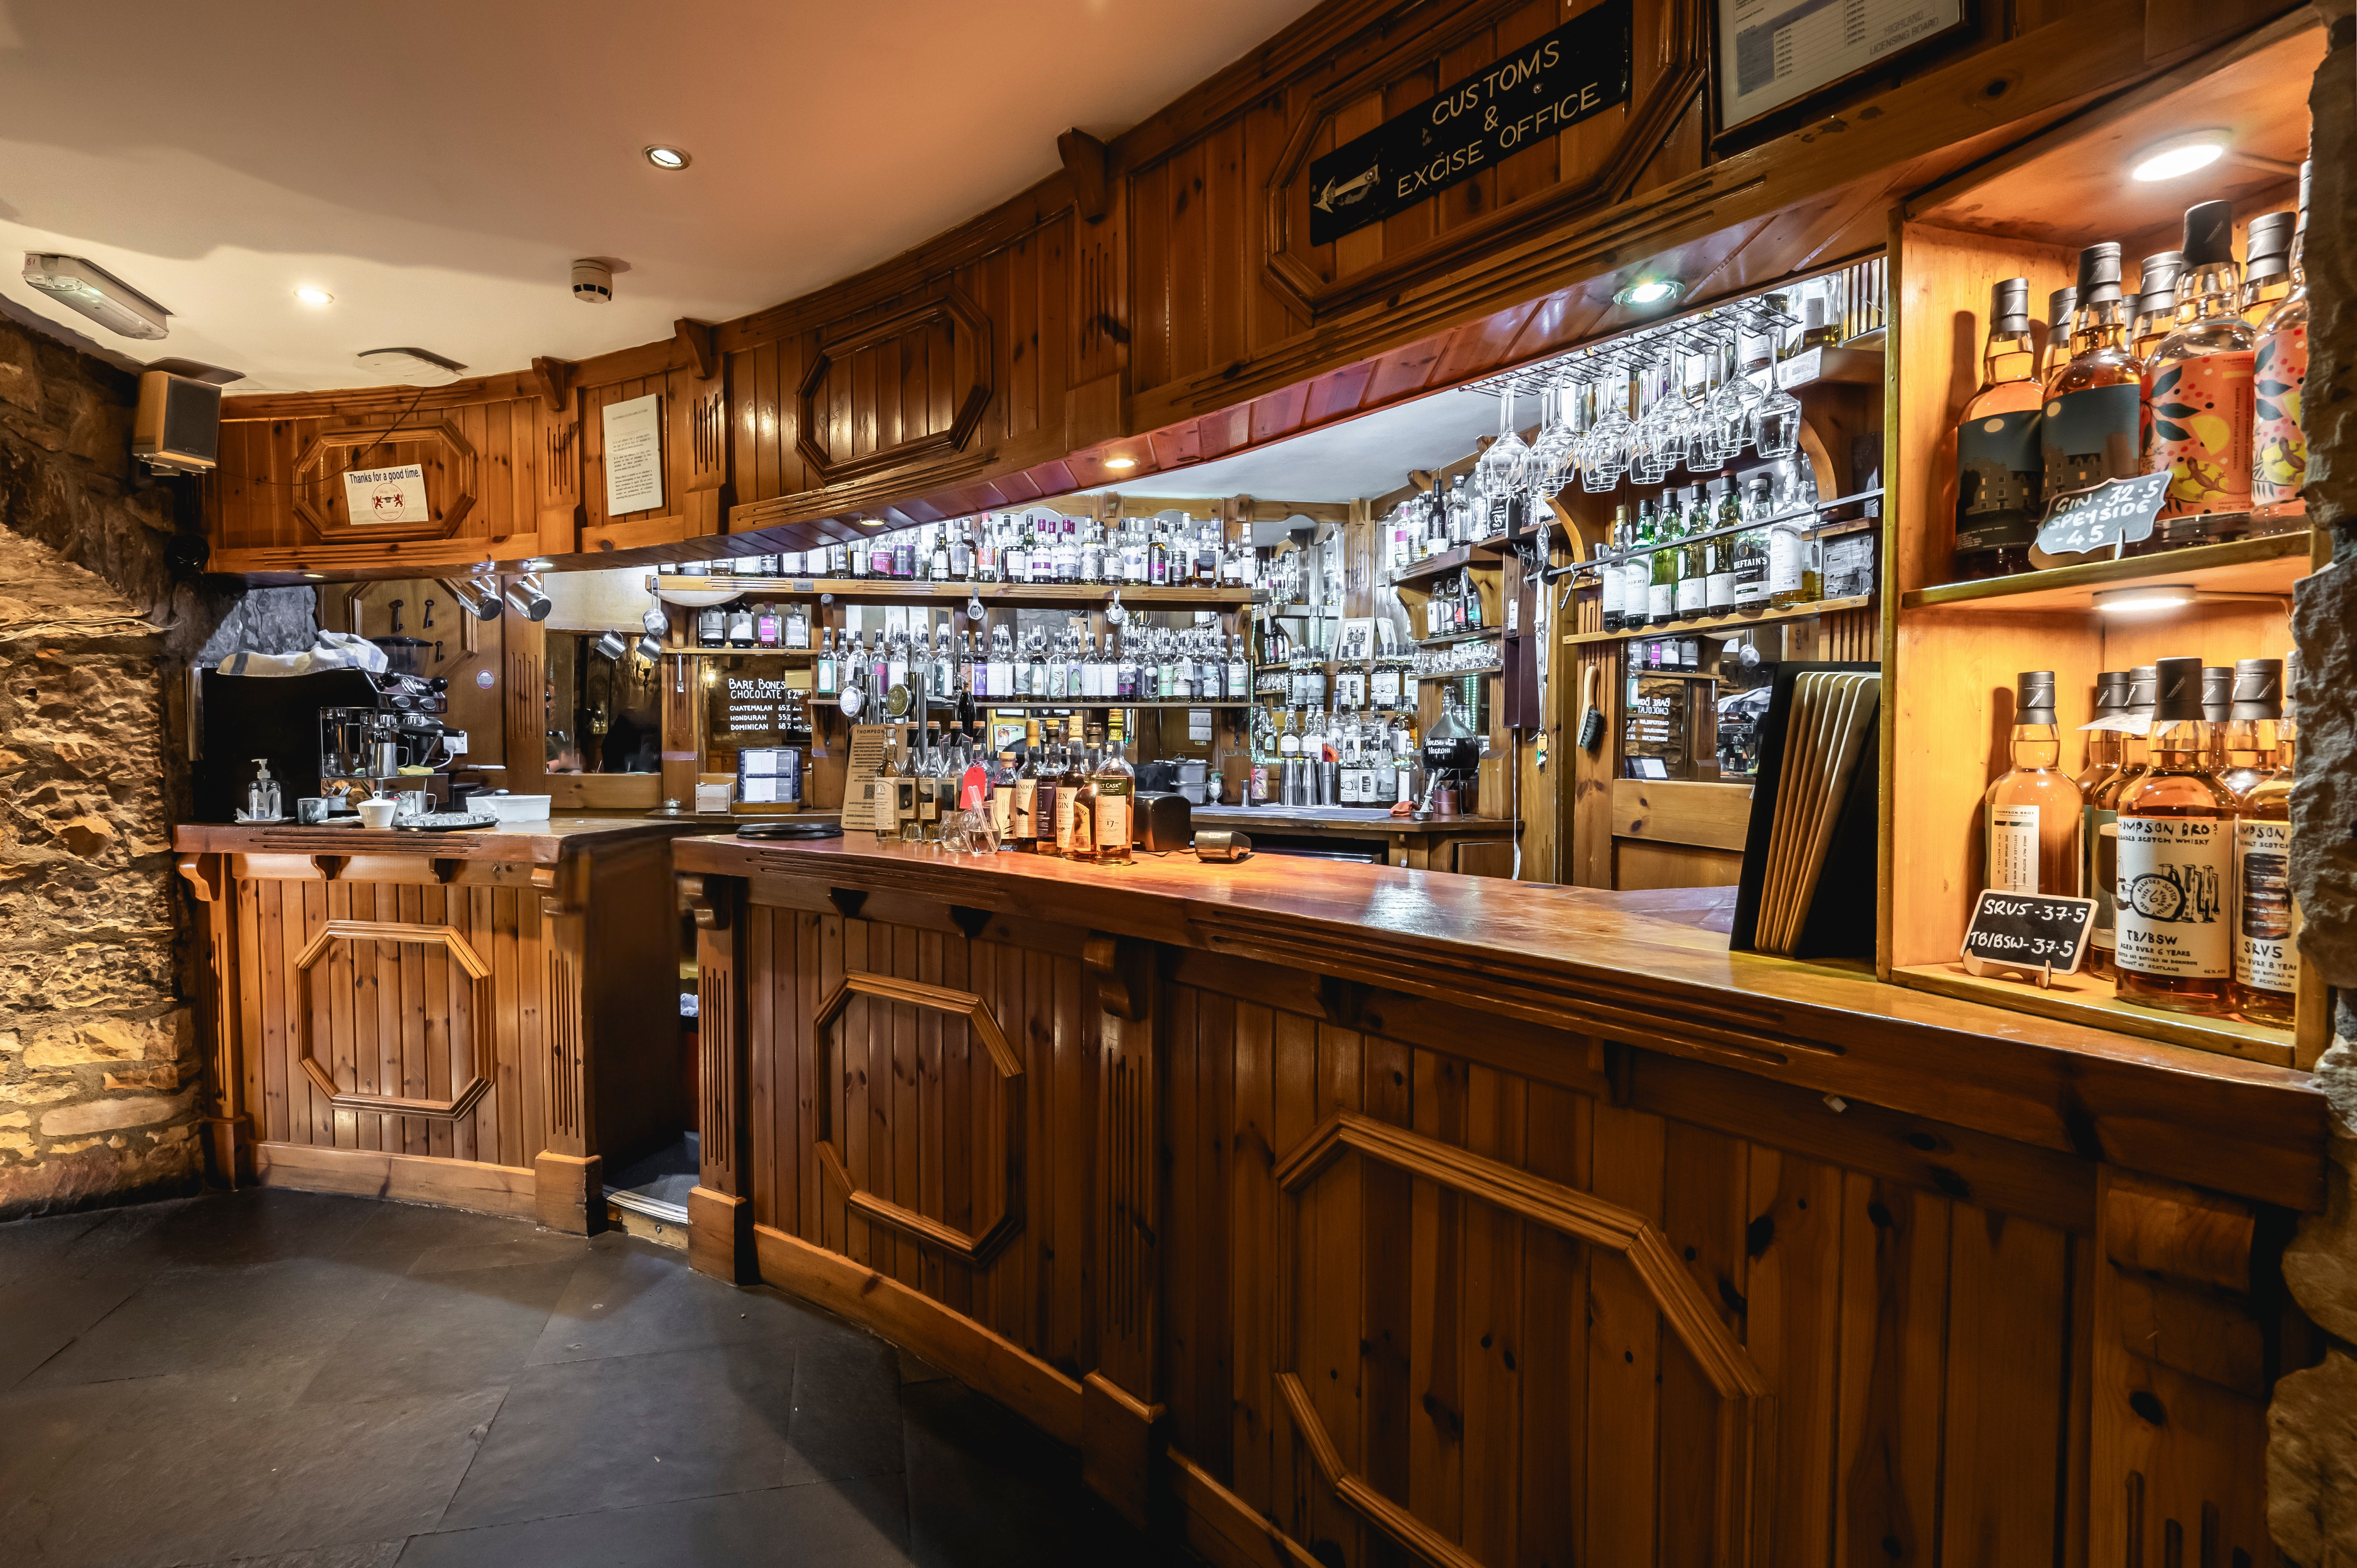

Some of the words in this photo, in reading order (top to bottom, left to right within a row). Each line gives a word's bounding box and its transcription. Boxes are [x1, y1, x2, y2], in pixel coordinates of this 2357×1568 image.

[1884, 10, 1923, 36] HIGHLAND
[1870, 30, 1909, 55] LICENSING
[1912, 17, 1939, 36] BOARD
[1432, 40, 1560, 125] CUSTOMS
[1484, 105, 1499, 132] &
[1397, 140, 1485, 198] EXCISE
[1499, 82, 1600, 148] OFFICE
[349, 473, 372, 484] Thanks
[373, 471, 381, 482] for
[389, 469, 404, 483] good
[405, 468, 420, 478] time.
[2055, 493, 2092, 513] GIN
[2048, 499, 2151, 530] SPEYSIDE
[728, 678, 754, 690] BARE
[758, 678, 786, 690] BONES
[731, 690, 781, 699] CHOCOLATE
[2137, 879, 2161, 892] BLENDED
[2162, 883, 2177, 901] SCOTCH
[2141, 888, 2151, 899] OVER
[2150, 890, 2158, 902] 6
[2127, 930, 2177, 945] TB/BSW
[2244, 941, 2283, 958] SRV5
[2248, 958, 2265, 967] OVER
[2259, 978, 2291, 987] SCOTLAND
